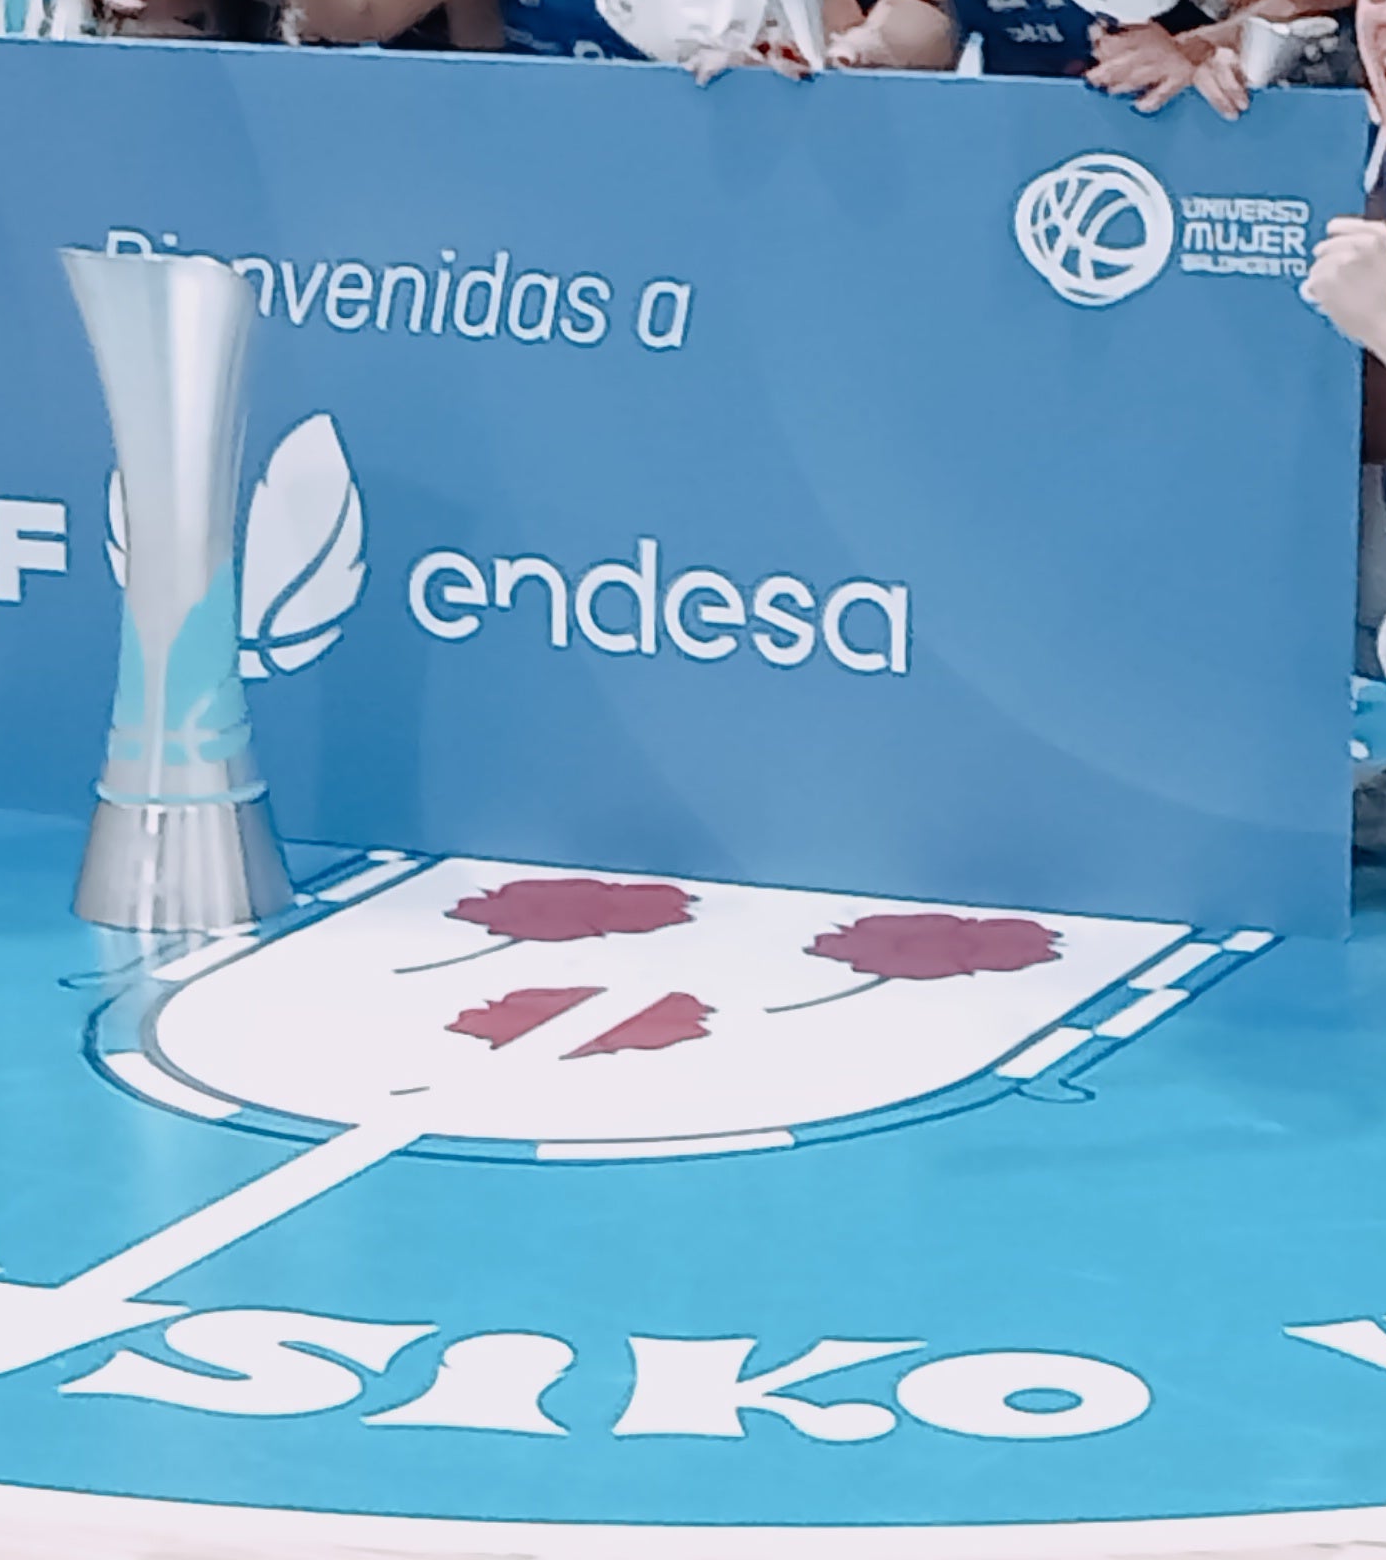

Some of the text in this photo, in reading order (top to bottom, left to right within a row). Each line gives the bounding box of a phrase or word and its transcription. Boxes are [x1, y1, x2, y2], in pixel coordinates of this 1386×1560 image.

[1182, 197, 1310, 223] UNIVERSO
[1183, 222, 1308, 256] MUJER
[106, 229, 693, 349] nvenidas a
[409, 536, 911, 676] endesa
